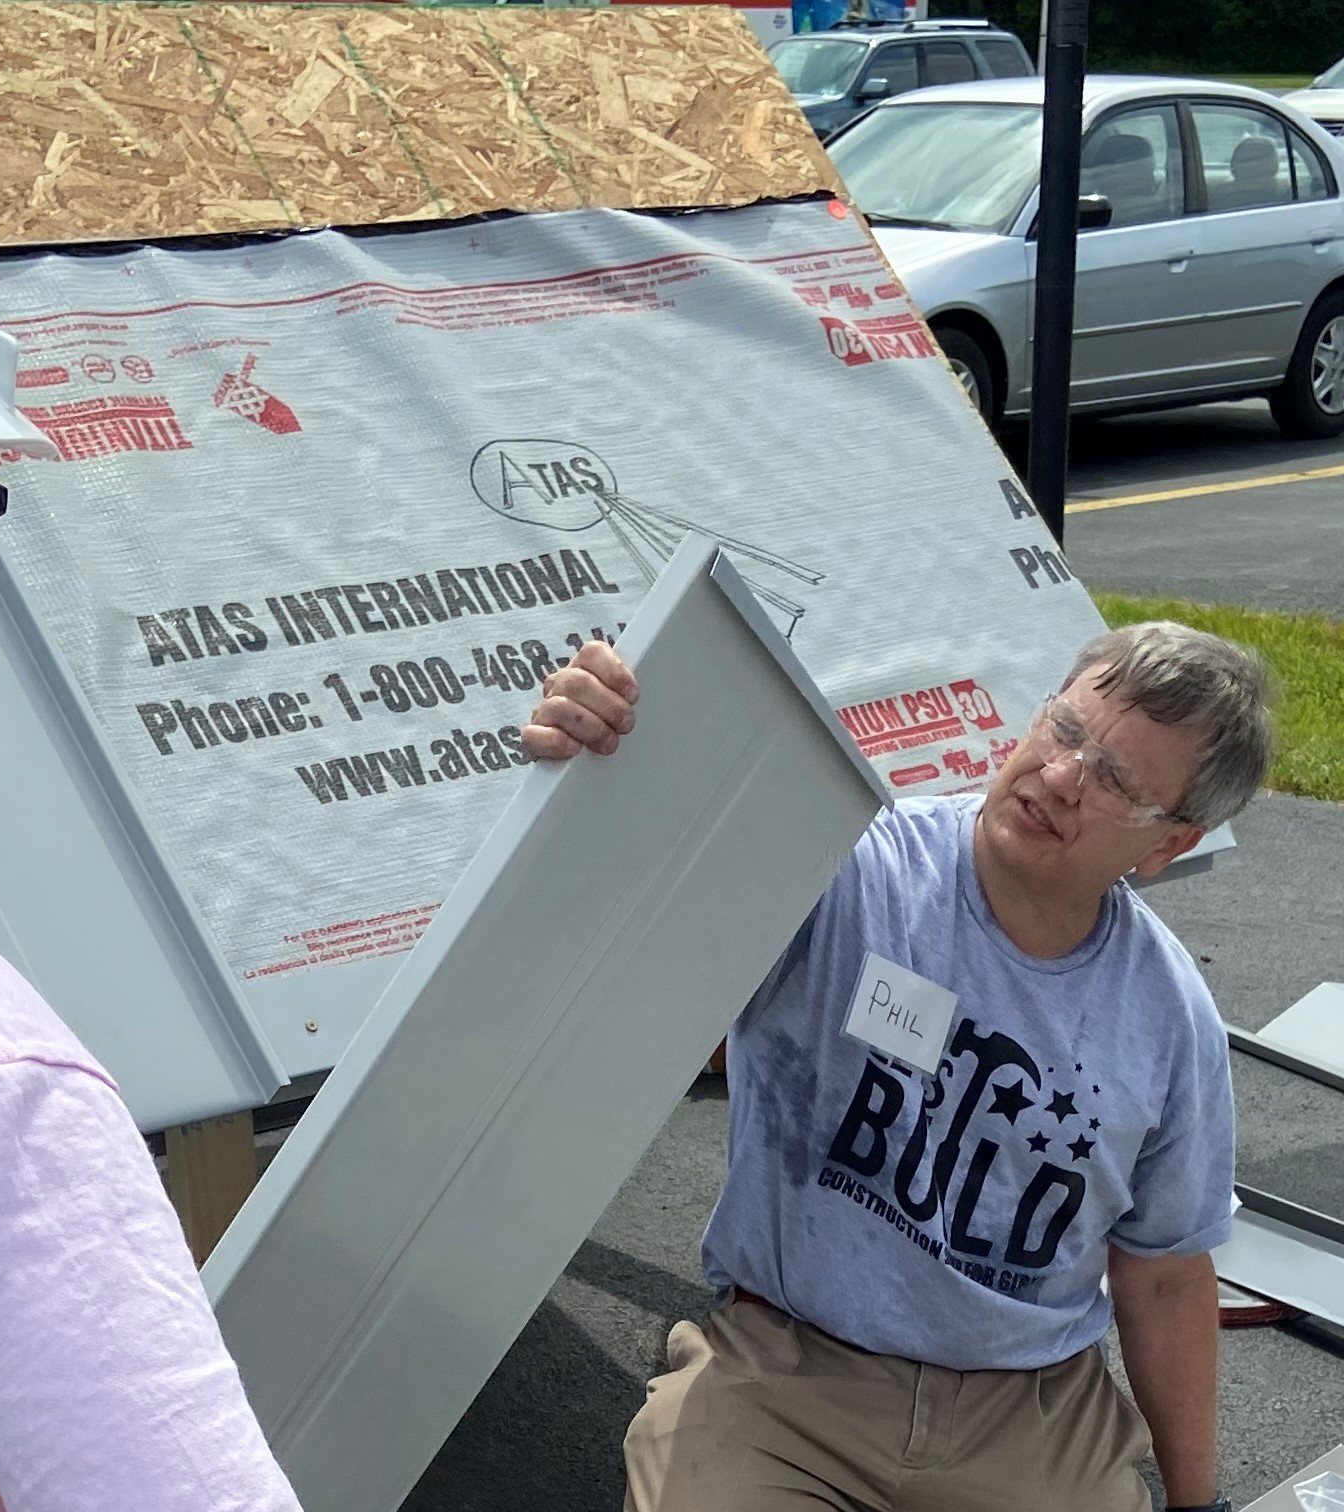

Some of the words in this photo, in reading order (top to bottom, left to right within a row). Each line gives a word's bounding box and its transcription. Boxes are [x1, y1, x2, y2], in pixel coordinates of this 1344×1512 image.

[830, 327, 864, 358] 30
[499, 450, 604, 509] ATAS
[137, 600, 269, 667] ATAS
[265, 548, 619, 648] INTERNATIONAL
[137, 690, 324, 756] Phone:
[324, 622, 628, 723] 1-800-468-
[900, 686, 954, 724] PSU
[958, 687, 992, 721] 30
[295, 721, 542, 803] www.atas
[868, 979, 925, 1040] PHIL
[817, 1166, 943, 1260] CONSTRUCTION
